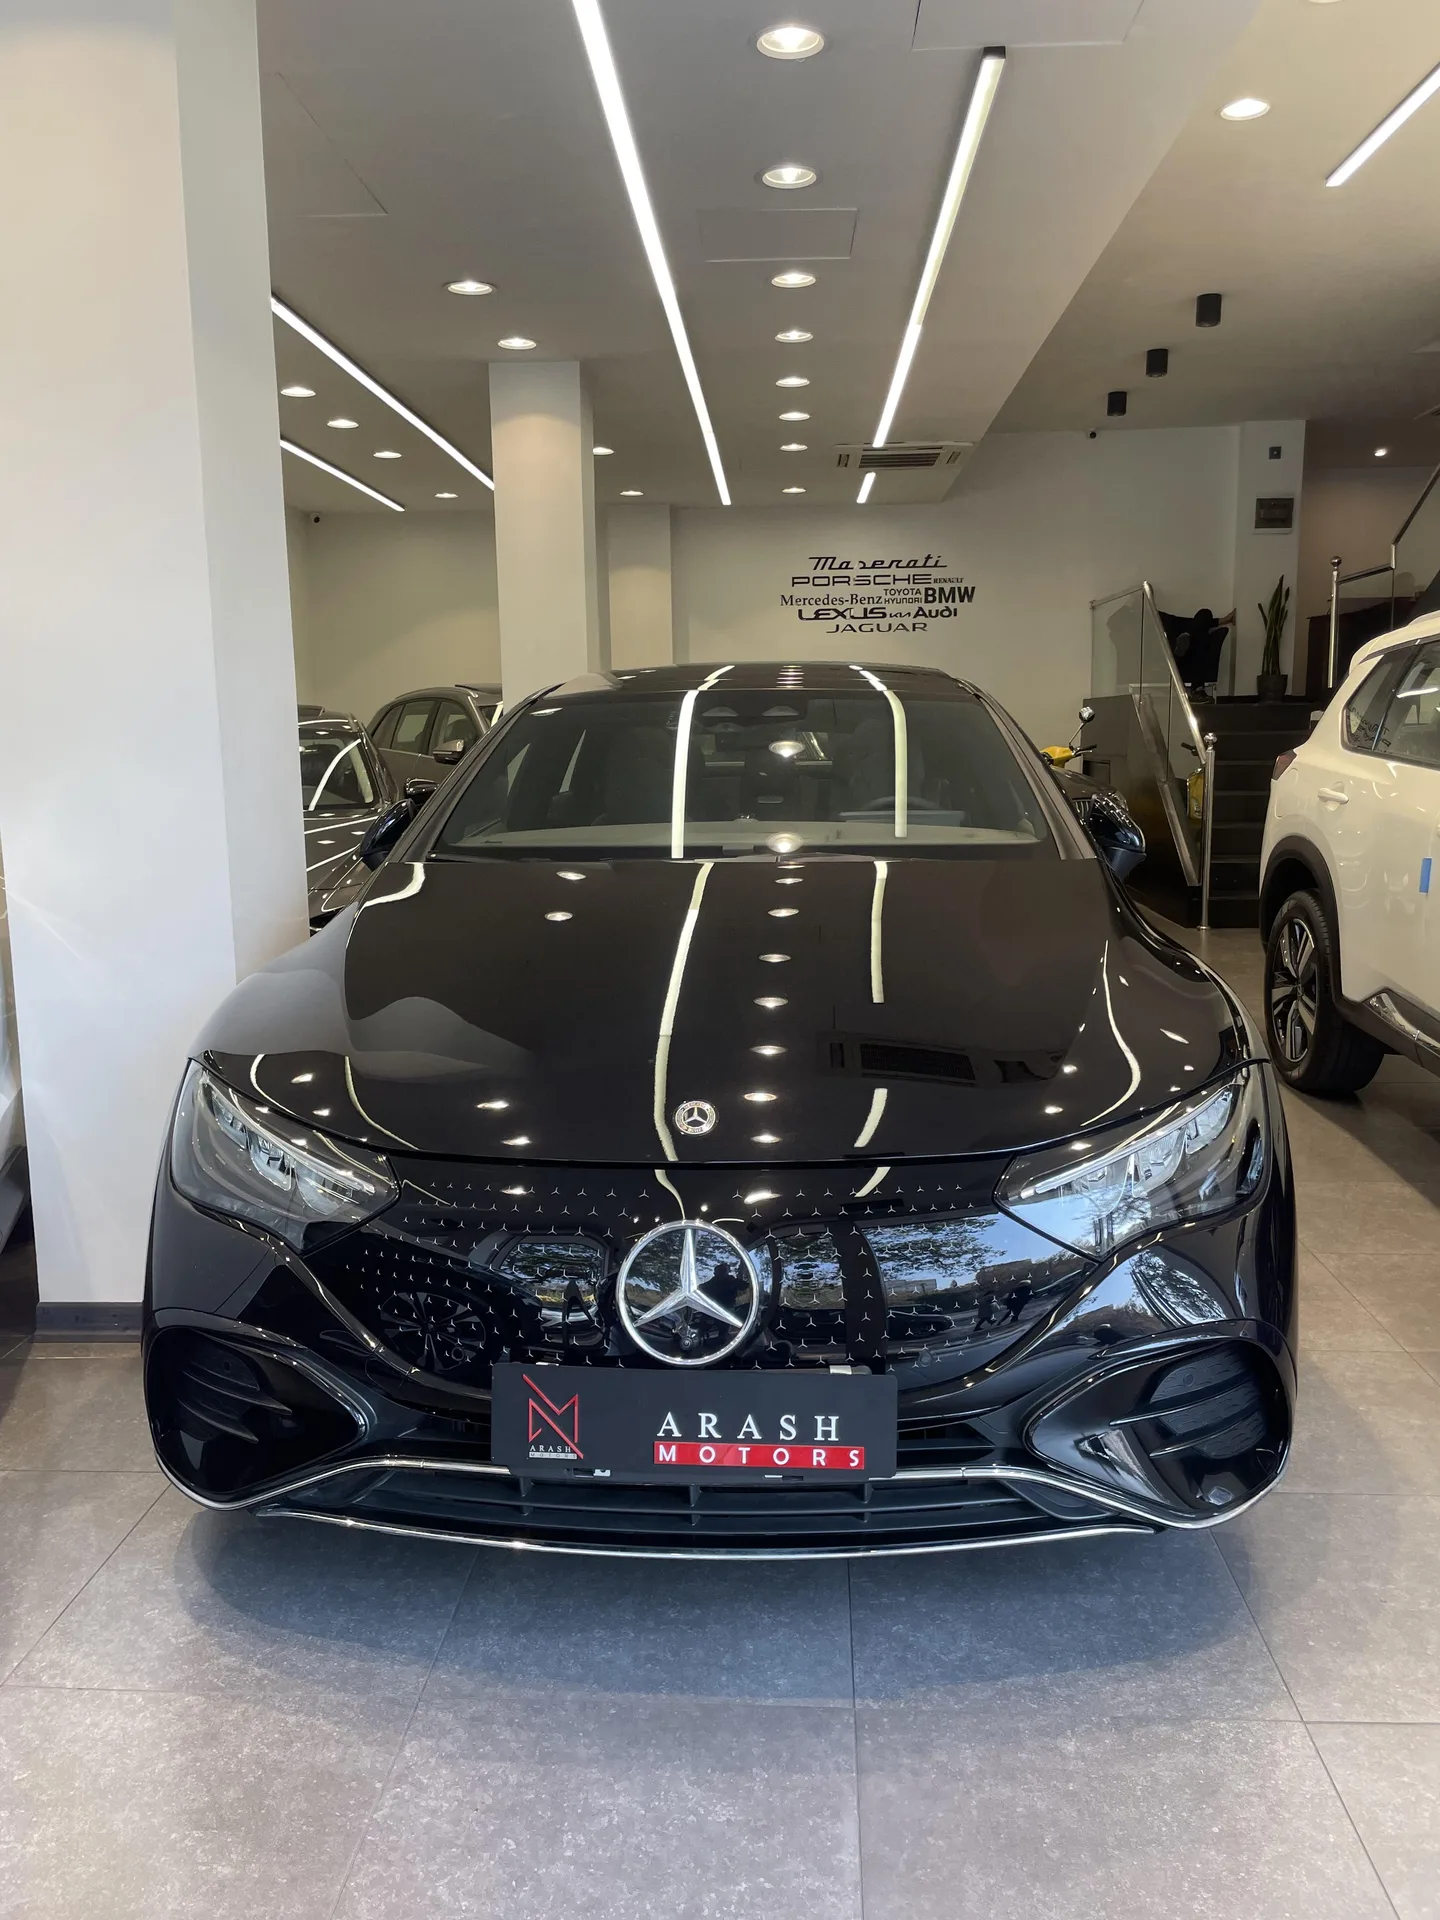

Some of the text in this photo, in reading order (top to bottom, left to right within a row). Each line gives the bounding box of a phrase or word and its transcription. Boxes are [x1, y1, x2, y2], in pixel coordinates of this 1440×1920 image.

[808, 553, 948, 571] Maserati
[792, 574, 932, 588] PORSCHE
[883, 588, 922, 596] TOYOTA
[924, 586, 976, 604] BMW
[780, 593, 882, 606] Mercedes-Benz
[798, 606, 887, 620] LEXUS
[826, 622, 928, 634] JAGUAR
[656, 1411, 840, 1442] ARASH
[530, 1444, 571, 1453] ARASH
[658, 1444, 860, 1467] MOTORS
